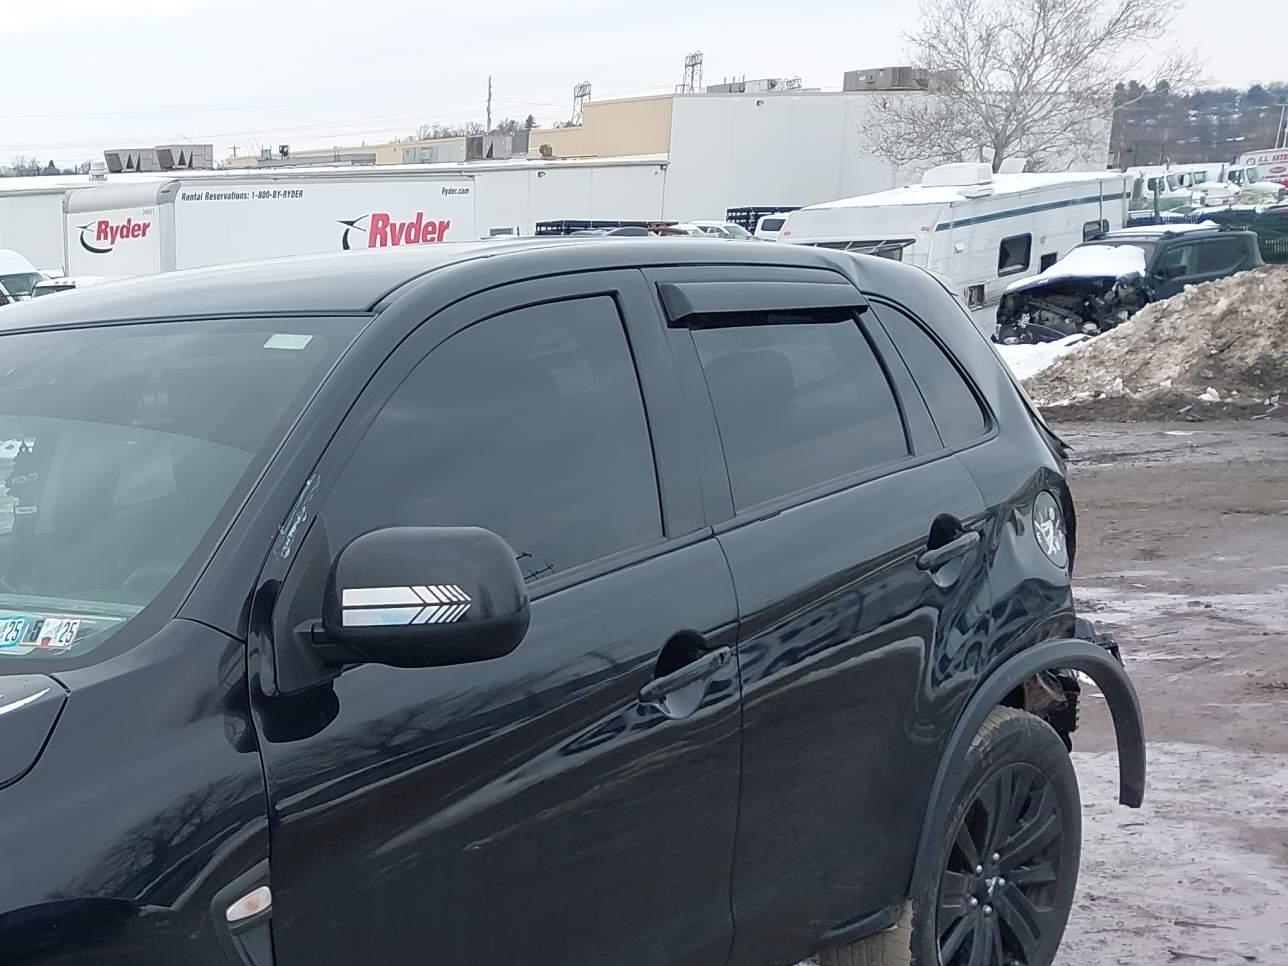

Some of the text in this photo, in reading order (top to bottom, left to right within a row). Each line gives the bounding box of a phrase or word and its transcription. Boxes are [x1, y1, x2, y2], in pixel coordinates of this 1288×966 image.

[181, 192, 203, 201] Rental
[205, 191, 250, 201] Reservations:
[96, 217, 151, 246] Ryder
[368, 211, 451, 248] Ryder
